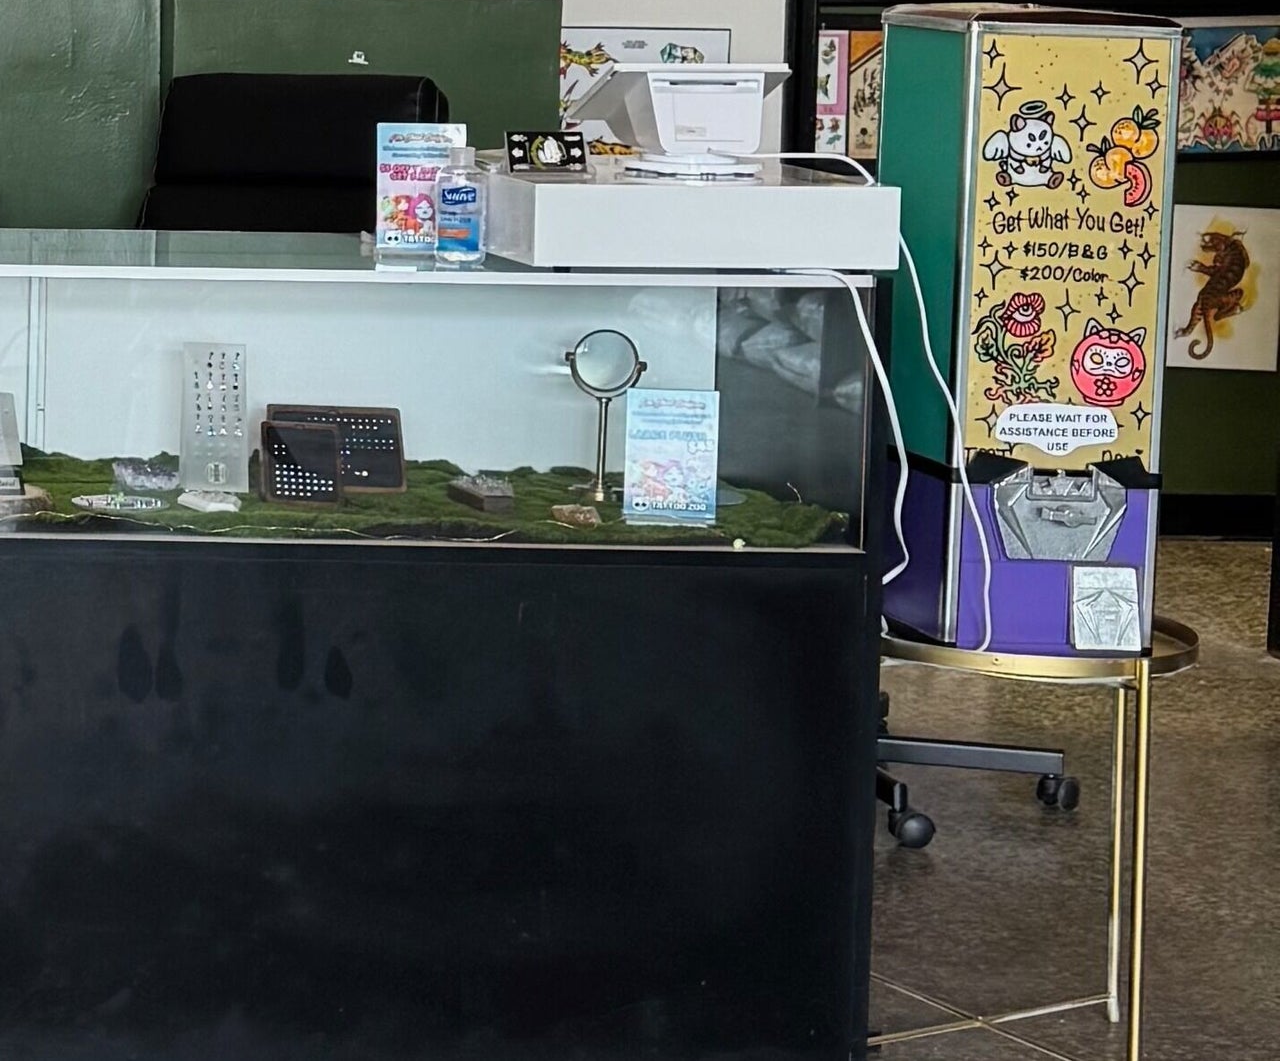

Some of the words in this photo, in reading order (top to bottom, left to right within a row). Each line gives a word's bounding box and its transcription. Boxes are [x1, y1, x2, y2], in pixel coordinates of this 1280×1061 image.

[443, 189, 476, 202] Suave
[992, 210, 1023, 234] Get
[1028, 206, 1069, 231] What
[1075, 210, 1106, 232] You
[1109, 211, 1146, 238] Get!
[403, 235, 436, 244] TATTO
[1020, 266, 1109, 284] $200/Color
[1009, 412, 1053, 423] PLEASE
[1056, 413, 1084, 423] WAIT
[1085, 414, 1108, 424] FOR
[999, 427, 1070, 437] ASSISTANCE
[1072, 428, 1116, 438] BEFORE
[1047, 442, 1069, 452] USE
[652, 501, 687, 511] TATTOO
[688, 502, 707, 511] ZOO
